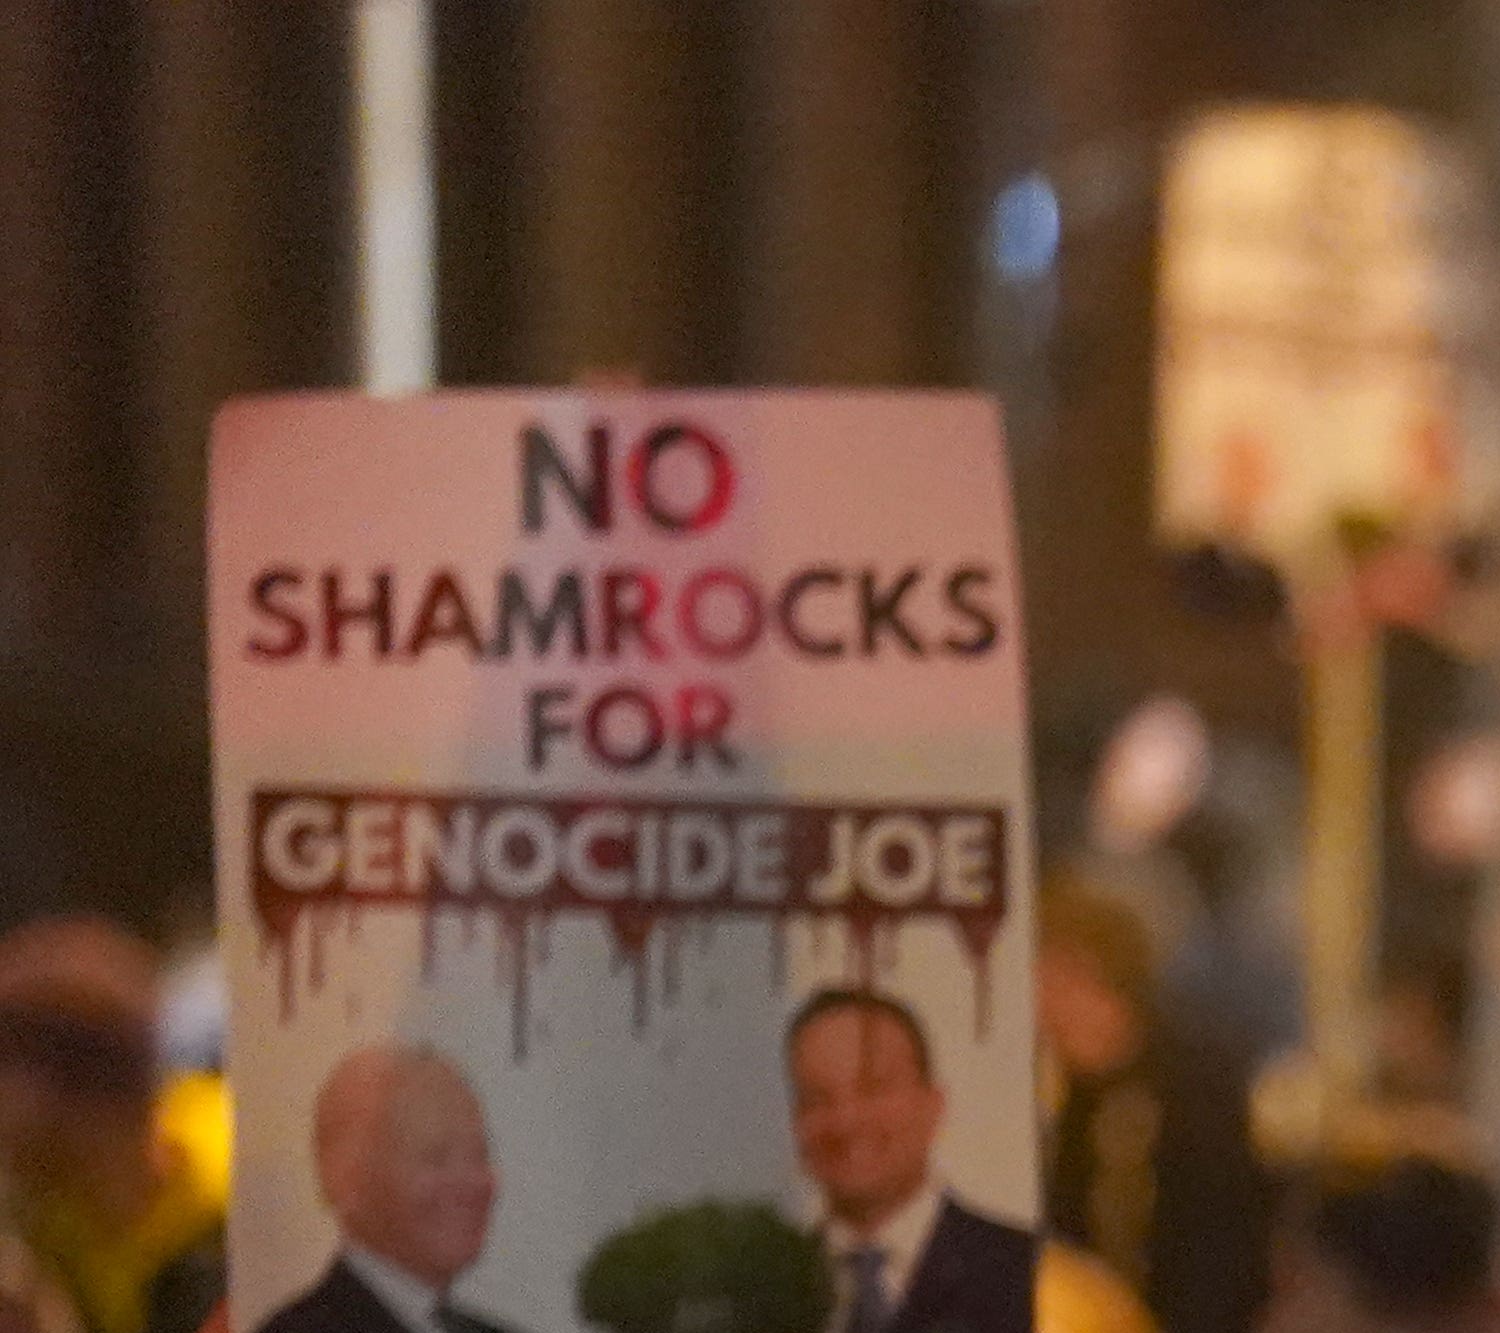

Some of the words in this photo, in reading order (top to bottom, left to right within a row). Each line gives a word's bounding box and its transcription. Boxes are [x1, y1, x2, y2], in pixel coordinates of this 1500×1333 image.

[519, 420, 736, 536] NO
[248, 563, 998, 664] SHAMROCKS
[526, 687, 739, 775] FOR
[262, 801, 790, 902] GENOCIDE
[806, 814, 995, 905] JOE
